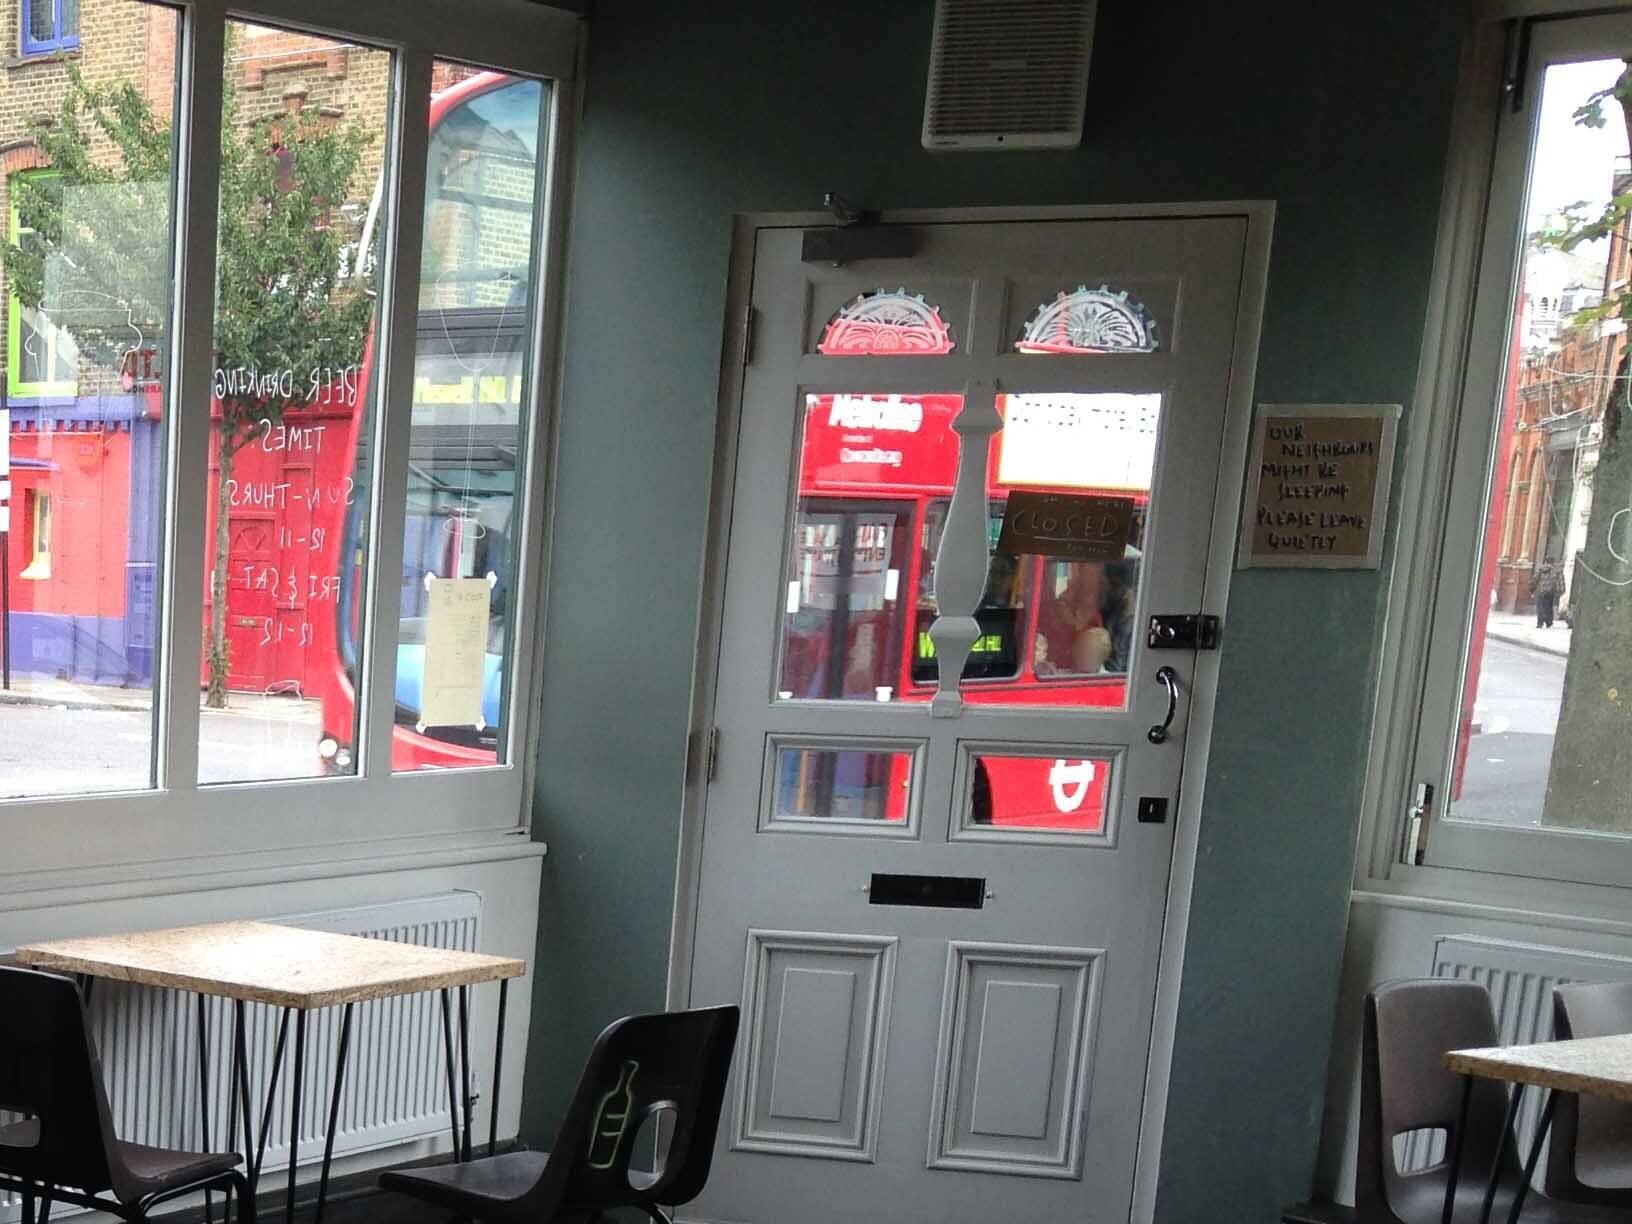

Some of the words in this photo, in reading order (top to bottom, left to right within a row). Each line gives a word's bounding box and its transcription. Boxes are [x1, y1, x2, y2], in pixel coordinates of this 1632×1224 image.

[1270, 424, 1304, 440] OUR
[1261, 463, 1310, 480] MIGHT
[1012, 511, 1119, 536] CLOSED
[1258, 507, 1315, 527] PLEASE
[1321, 513, 1365, 529] LEAVE
